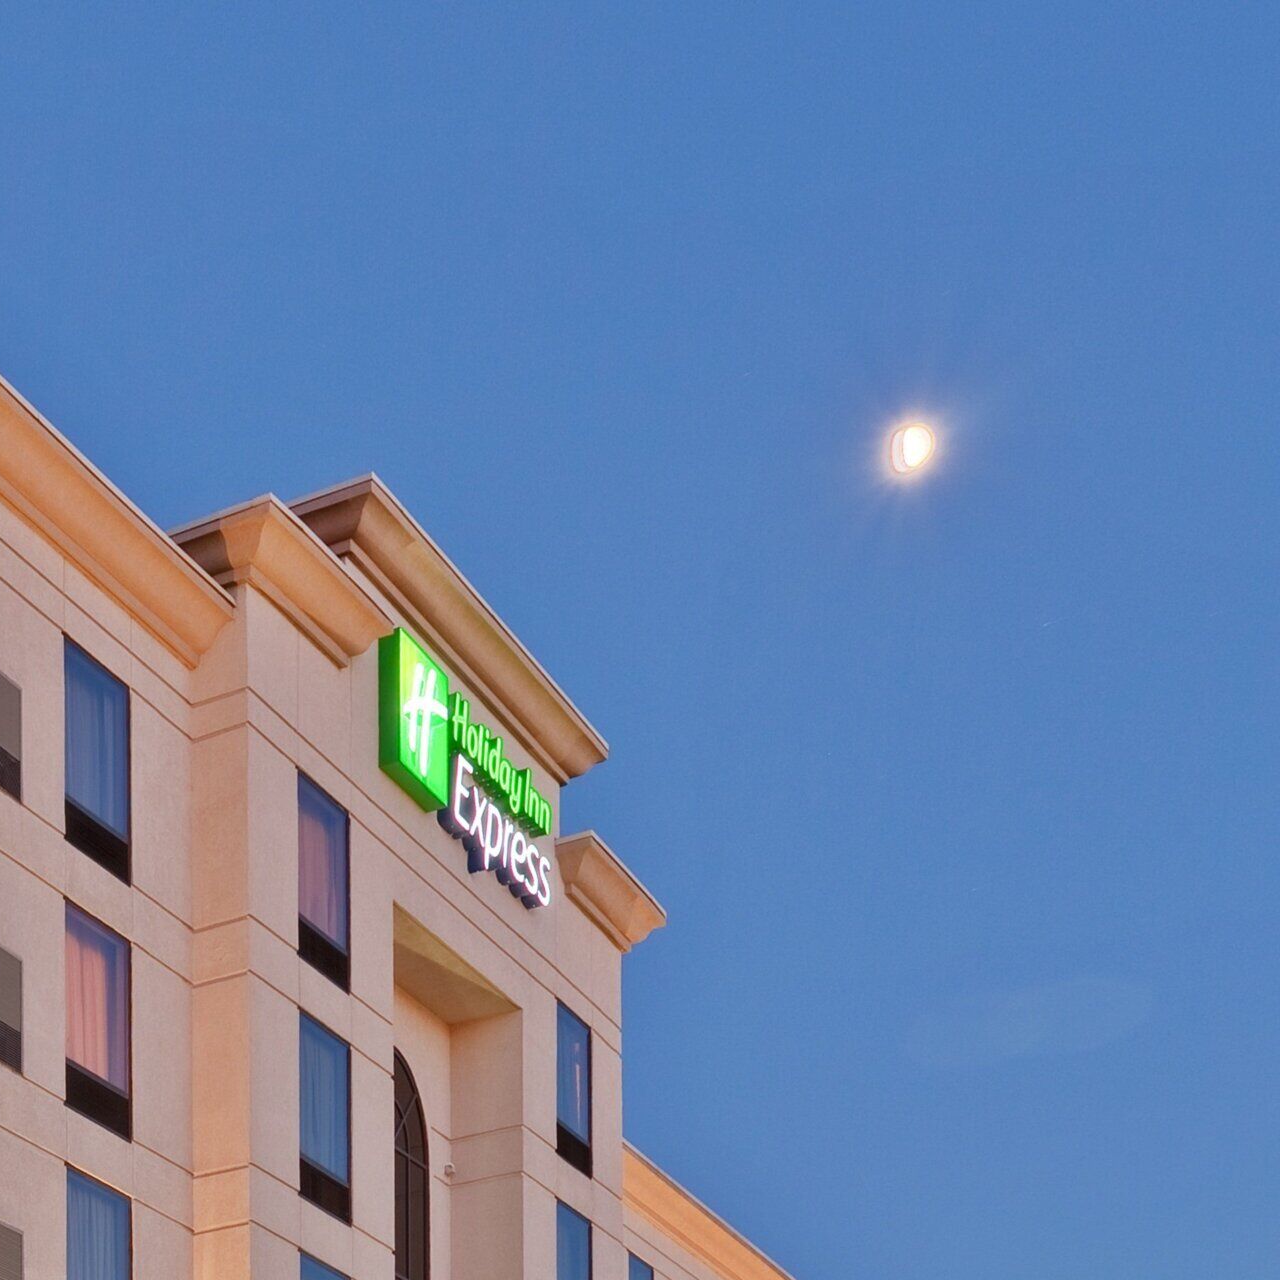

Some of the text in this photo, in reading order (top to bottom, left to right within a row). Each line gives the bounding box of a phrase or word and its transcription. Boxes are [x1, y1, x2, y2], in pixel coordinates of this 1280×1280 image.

[451, 691, 552, 836] Holiday Inn
[452, 753, 552, 907] Express
